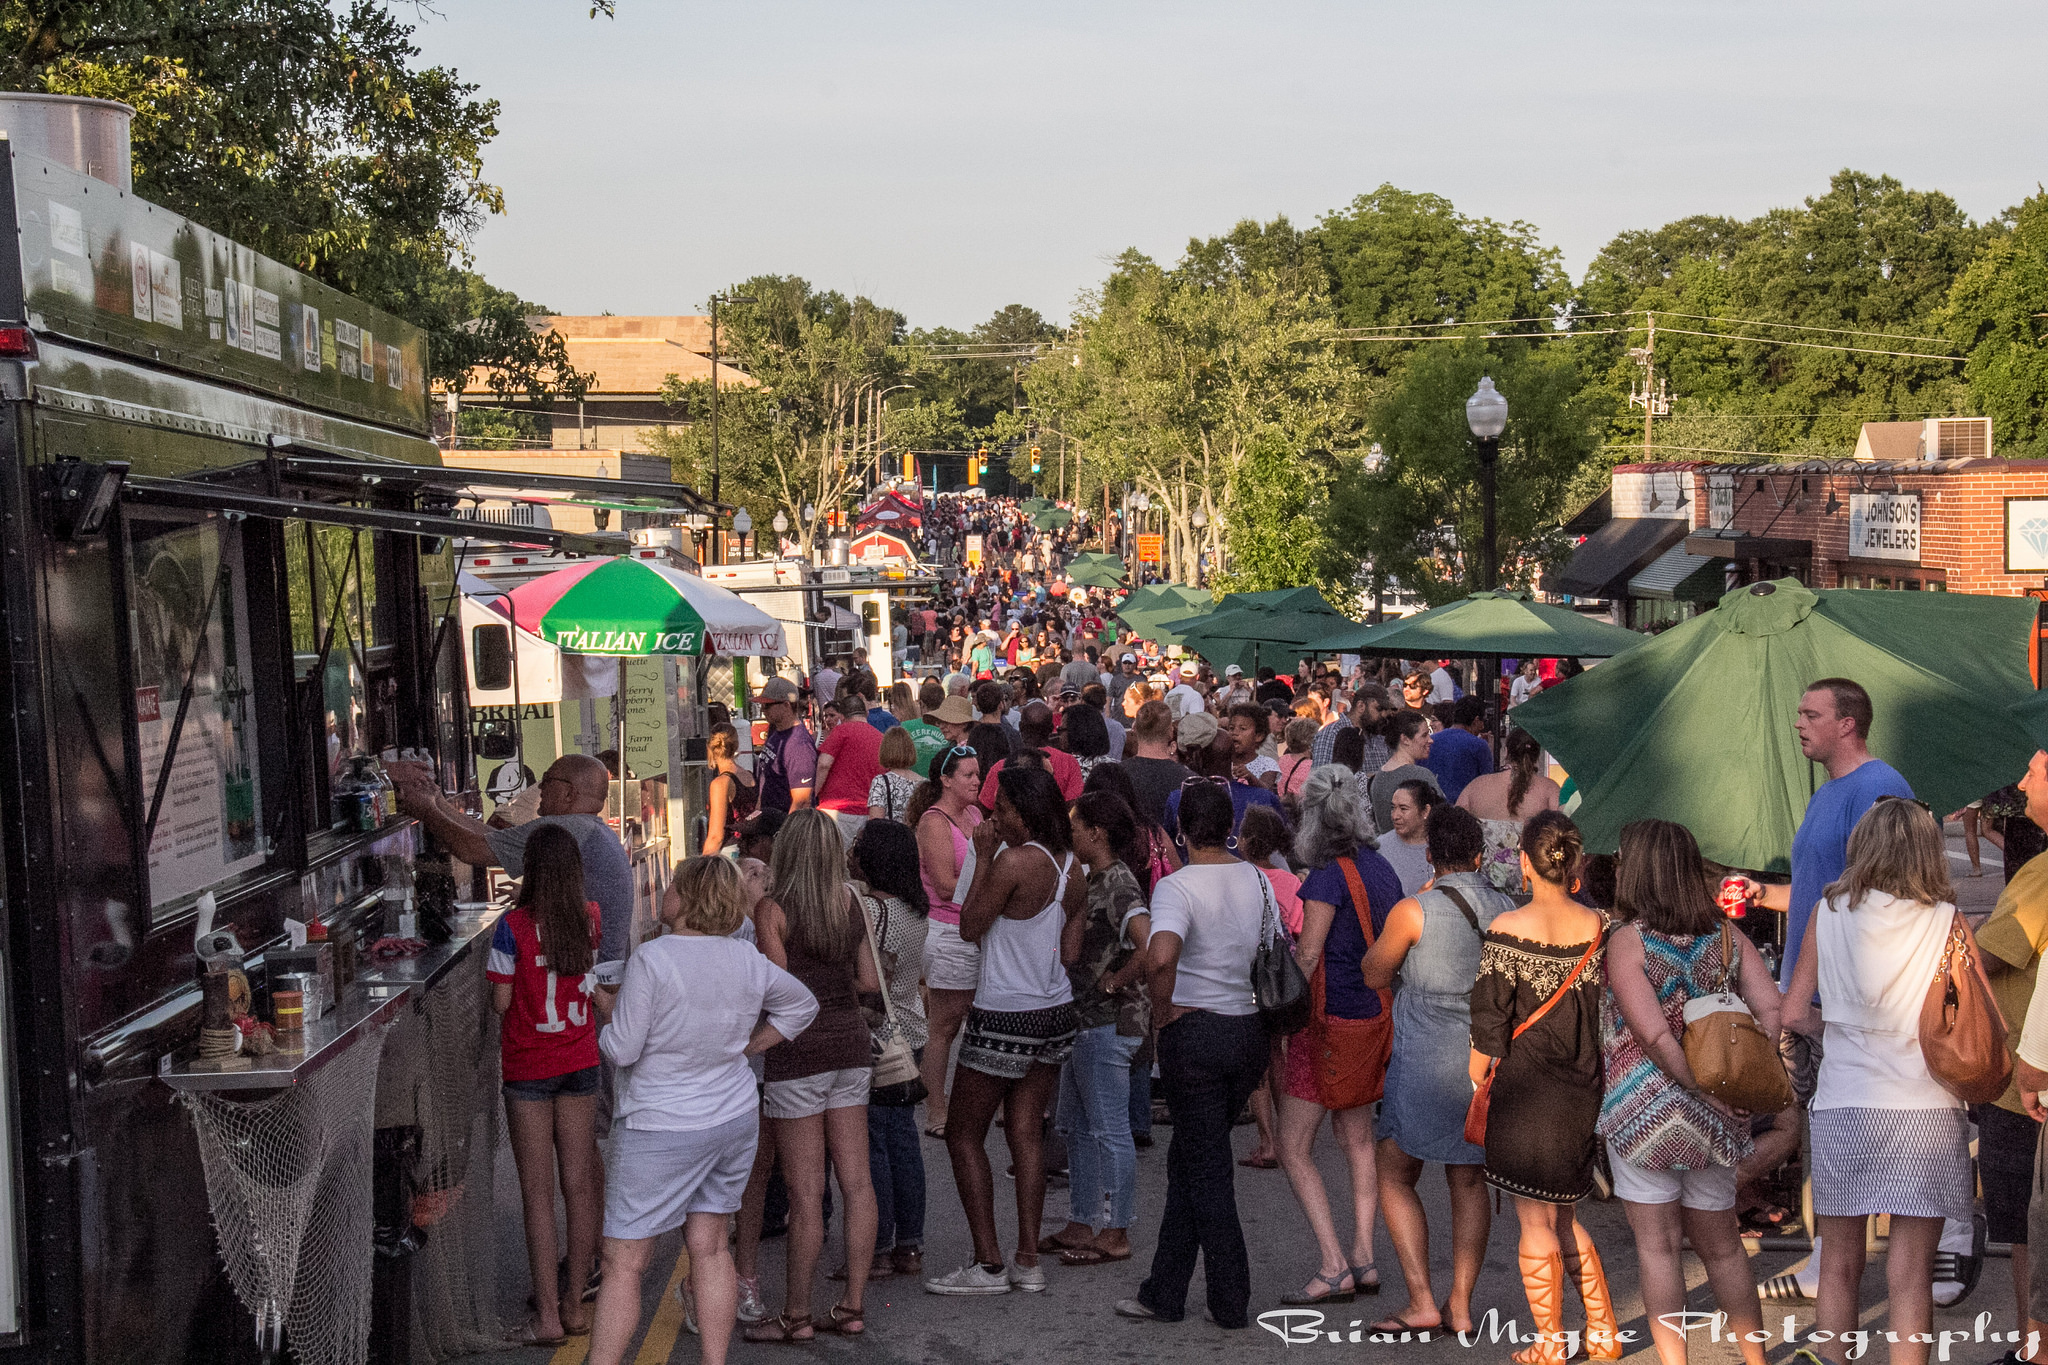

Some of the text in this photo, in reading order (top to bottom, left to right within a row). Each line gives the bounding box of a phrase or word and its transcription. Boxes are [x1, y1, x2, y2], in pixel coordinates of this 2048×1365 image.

[305, 351, 320, 368] CNBC
[1865, 498, 1917, 523] JOHNSON'S
[1865, 528, 1917, 550] JEWELERS
[556, 631, 647, 651] ITALIAN
[652, 632, 695, 651] ICE
[626, 686, 654, 696] berry
[628, 735, 653, 744] Farm
[911, 728, 949, 745] EERKNURD
